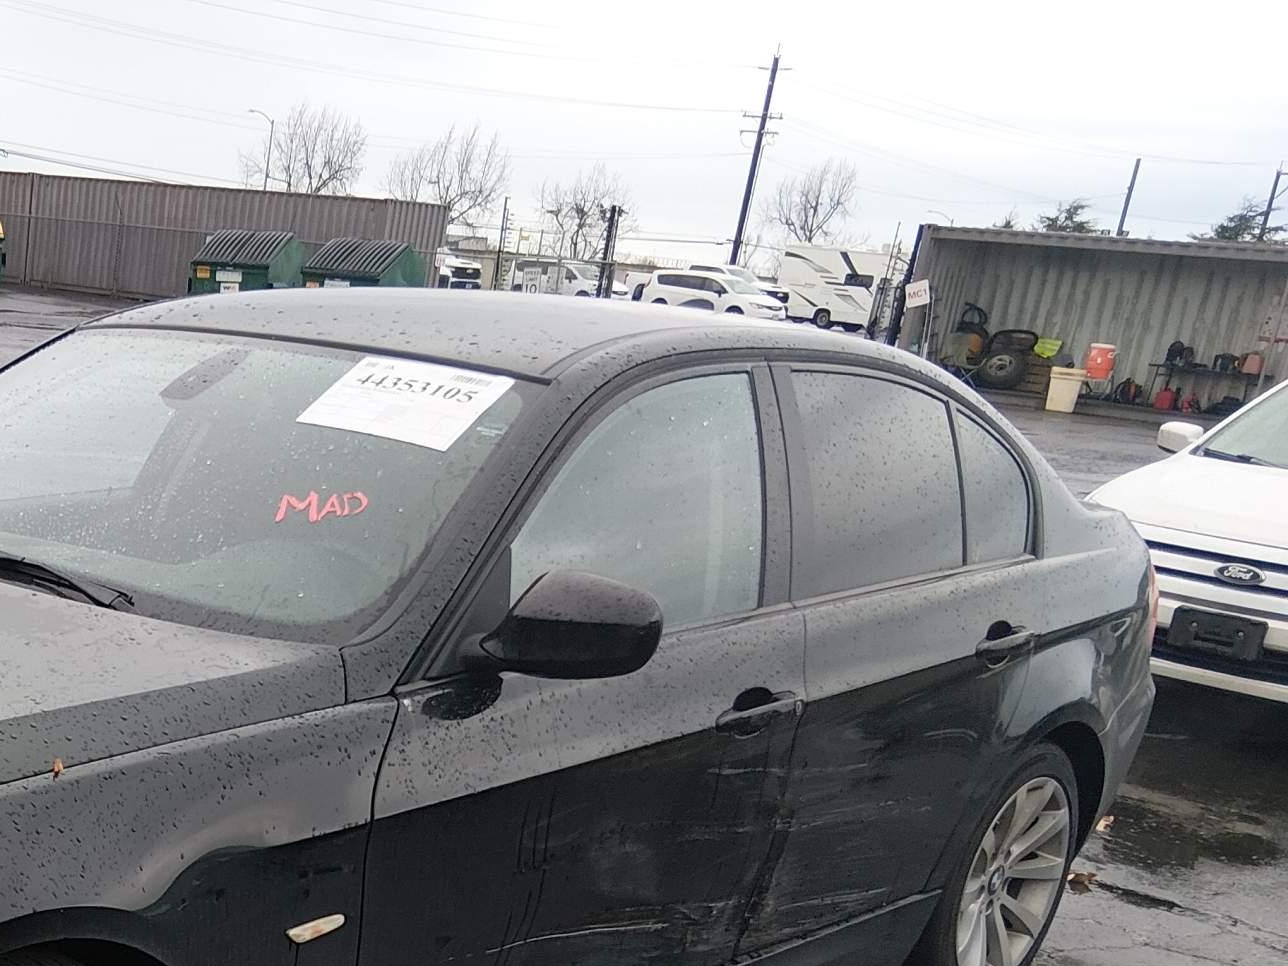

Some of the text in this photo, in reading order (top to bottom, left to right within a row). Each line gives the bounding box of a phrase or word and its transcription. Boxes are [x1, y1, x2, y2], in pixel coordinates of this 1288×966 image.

[908, 288, 927, 300] MC1
[357, 373, 478, 403] 44353105
[274, 490, 368, 523] MAD
[1223, 566, 1254, 580] Ford
